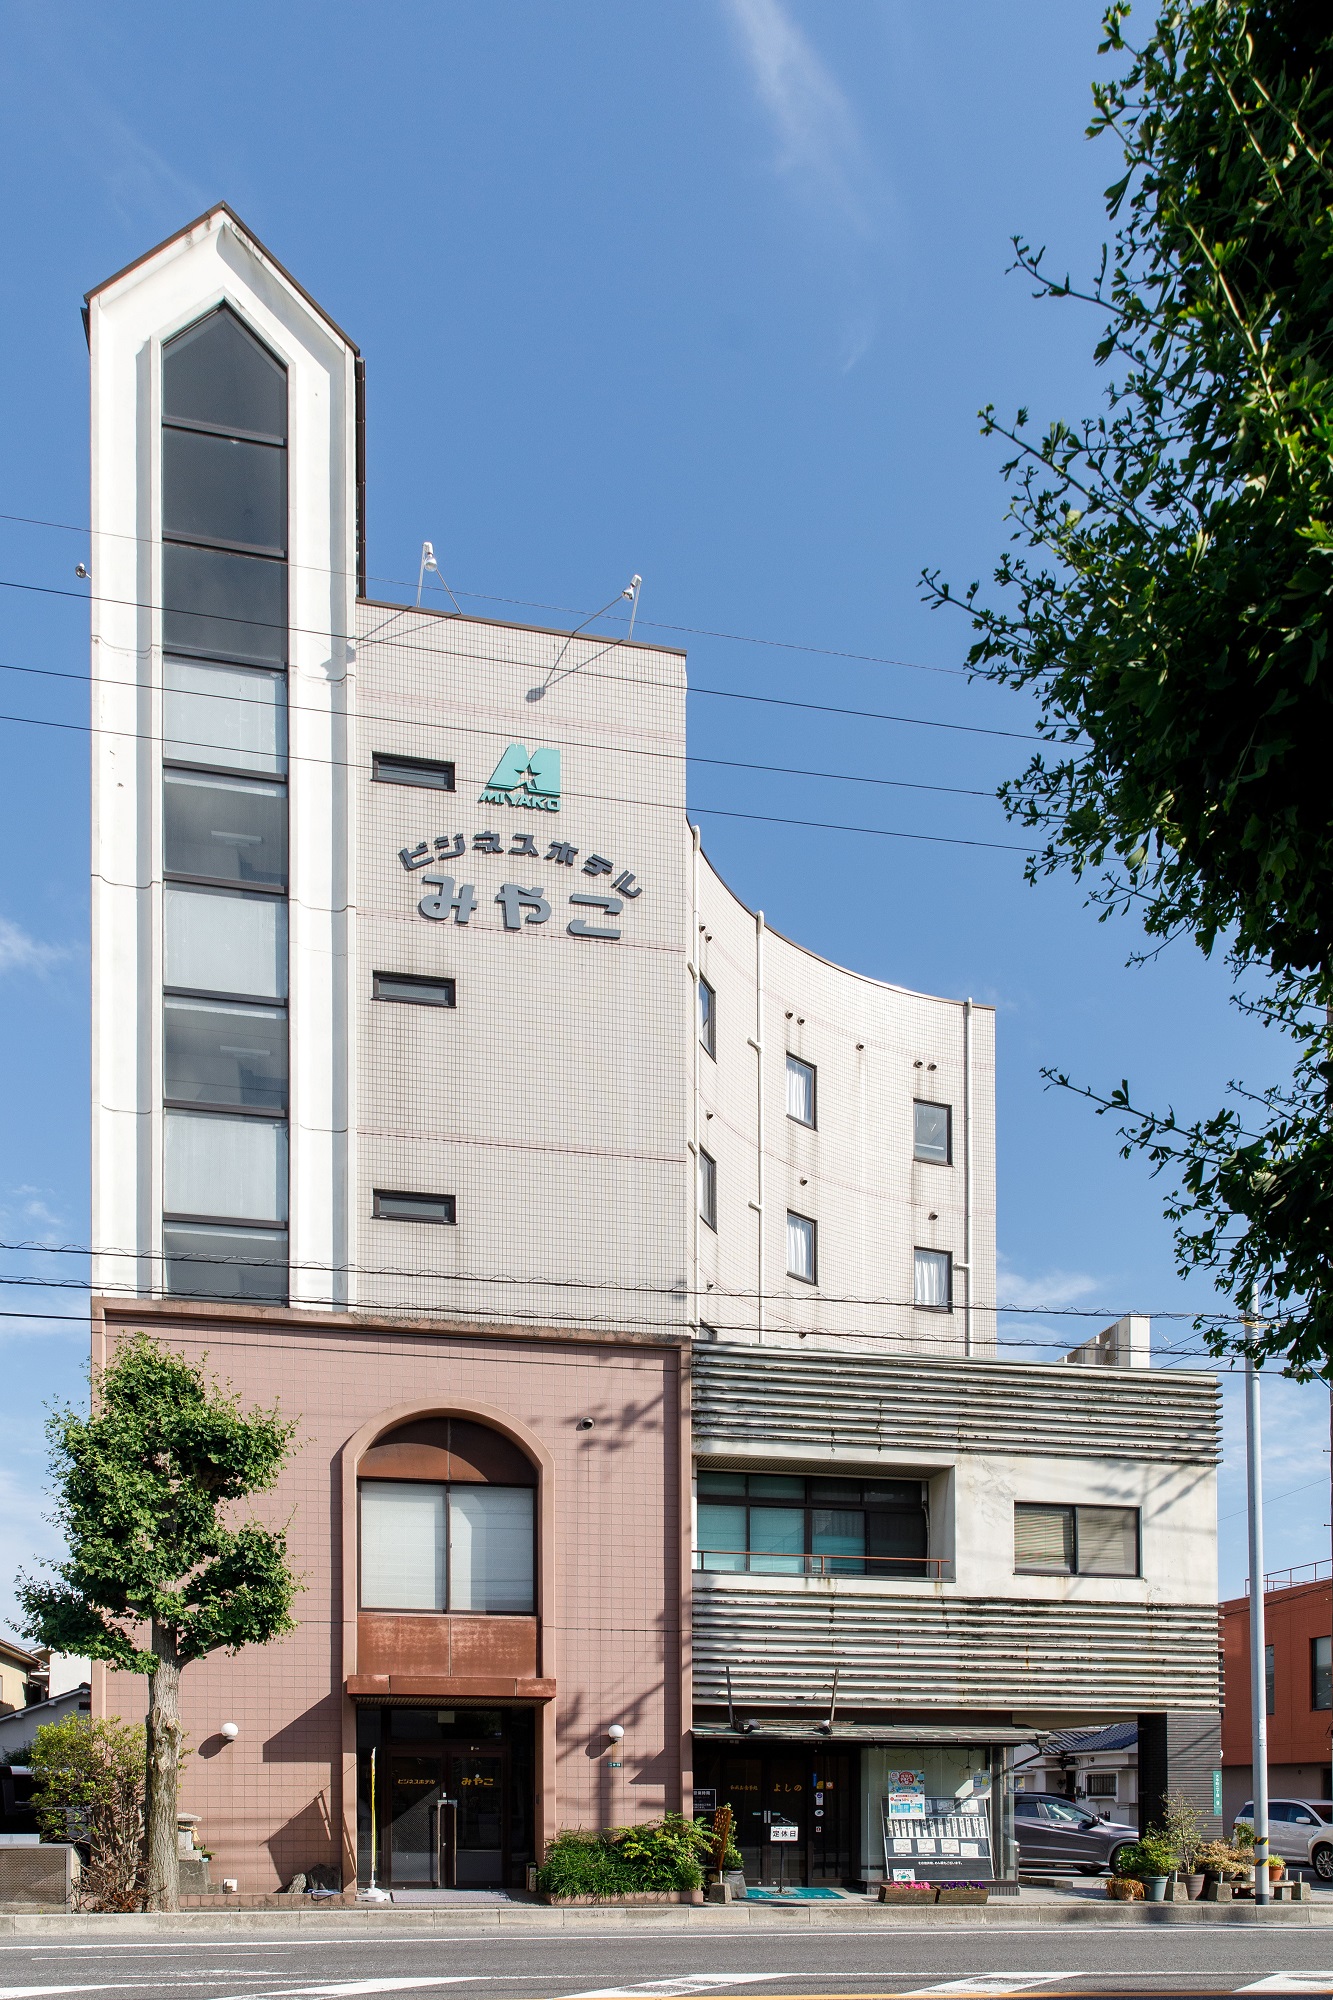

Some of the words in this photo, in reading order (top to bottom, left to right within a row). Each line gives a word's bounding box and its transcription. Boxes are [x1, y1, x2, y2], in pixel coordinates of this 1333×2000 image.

[478, 789, 561, 812] MIYAKO
[398, 830, 643, 898] ビジネスホテル
[418, 873, 624, 940] みやこ
[461, 1776, 494, 1786] みやこ
[774, 1783, 802, 1792] よしの
[772, 1829, 797, 1838] 定休日
